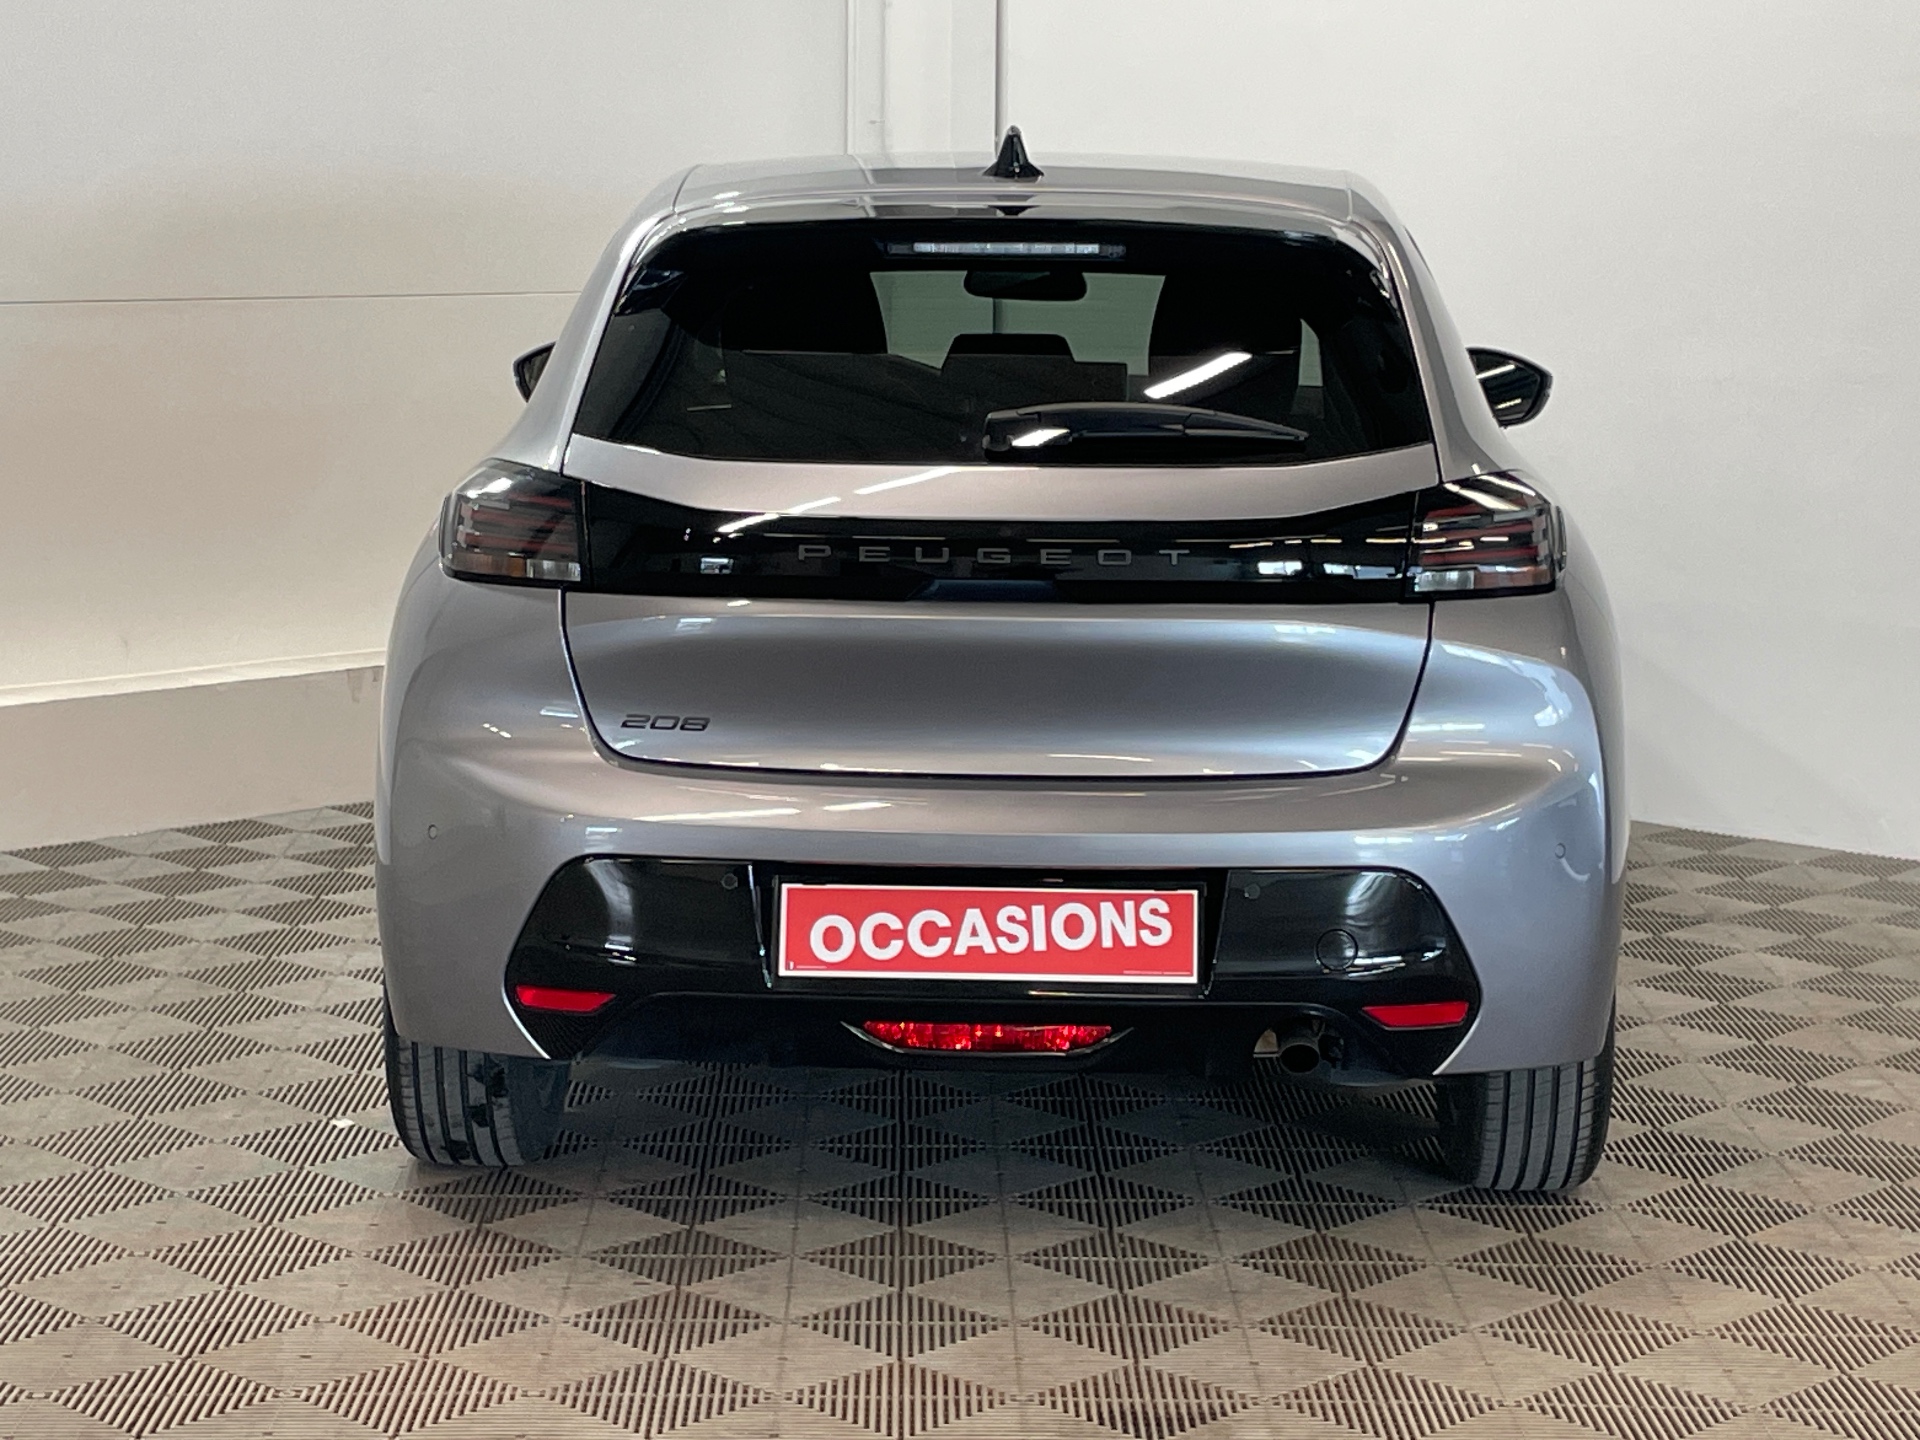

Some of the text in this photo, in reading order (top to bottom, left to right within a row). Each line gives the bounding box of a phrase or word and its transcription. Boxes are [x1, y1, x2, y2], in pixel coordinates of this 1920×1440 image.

[798, 544, 1190, 565] PEUGEOT
[620, 713, 711, 731] 208
[809, 898, 1173, 963] OCCASIONS
